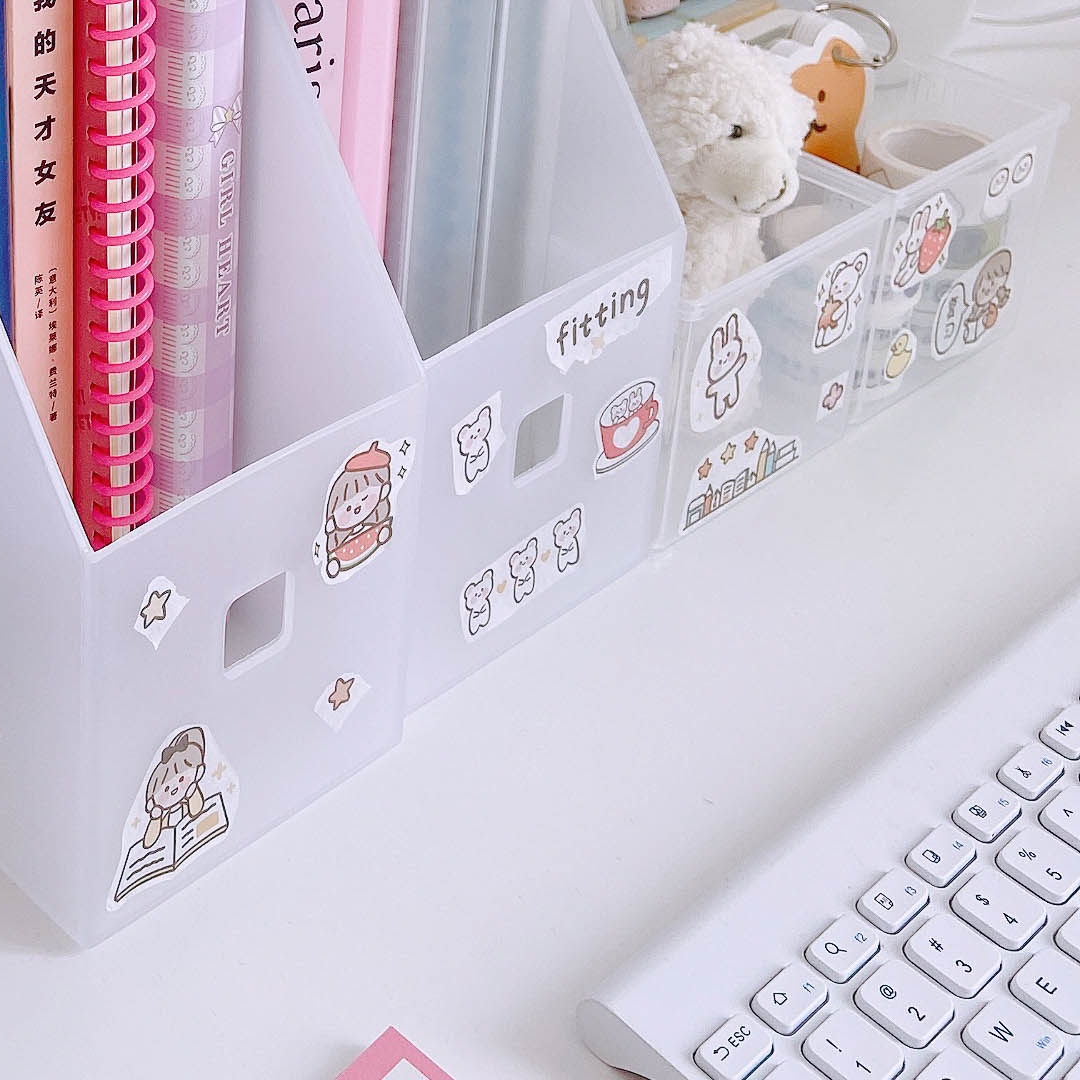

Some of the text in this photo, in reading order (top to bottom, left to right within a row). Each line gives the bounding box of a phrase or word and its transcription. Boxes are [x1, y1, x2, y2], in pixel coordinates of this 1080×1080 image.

[216, 149, 236, 337] GIRL HEART
[556, 278, 650, 356] fitting
[1045, 867, 1063, 881] 5
[1002, 912, 1019, 926] 4
[955, 958, 973, 973] 3
[1035, 976, 1059, 995] E
[907, 1006, 926, 1022] 2
[727, 1025, 752, 1049] ESC
[988, 1020, 1015, 1044] W
[855, 1059, 872, 1074] 1
